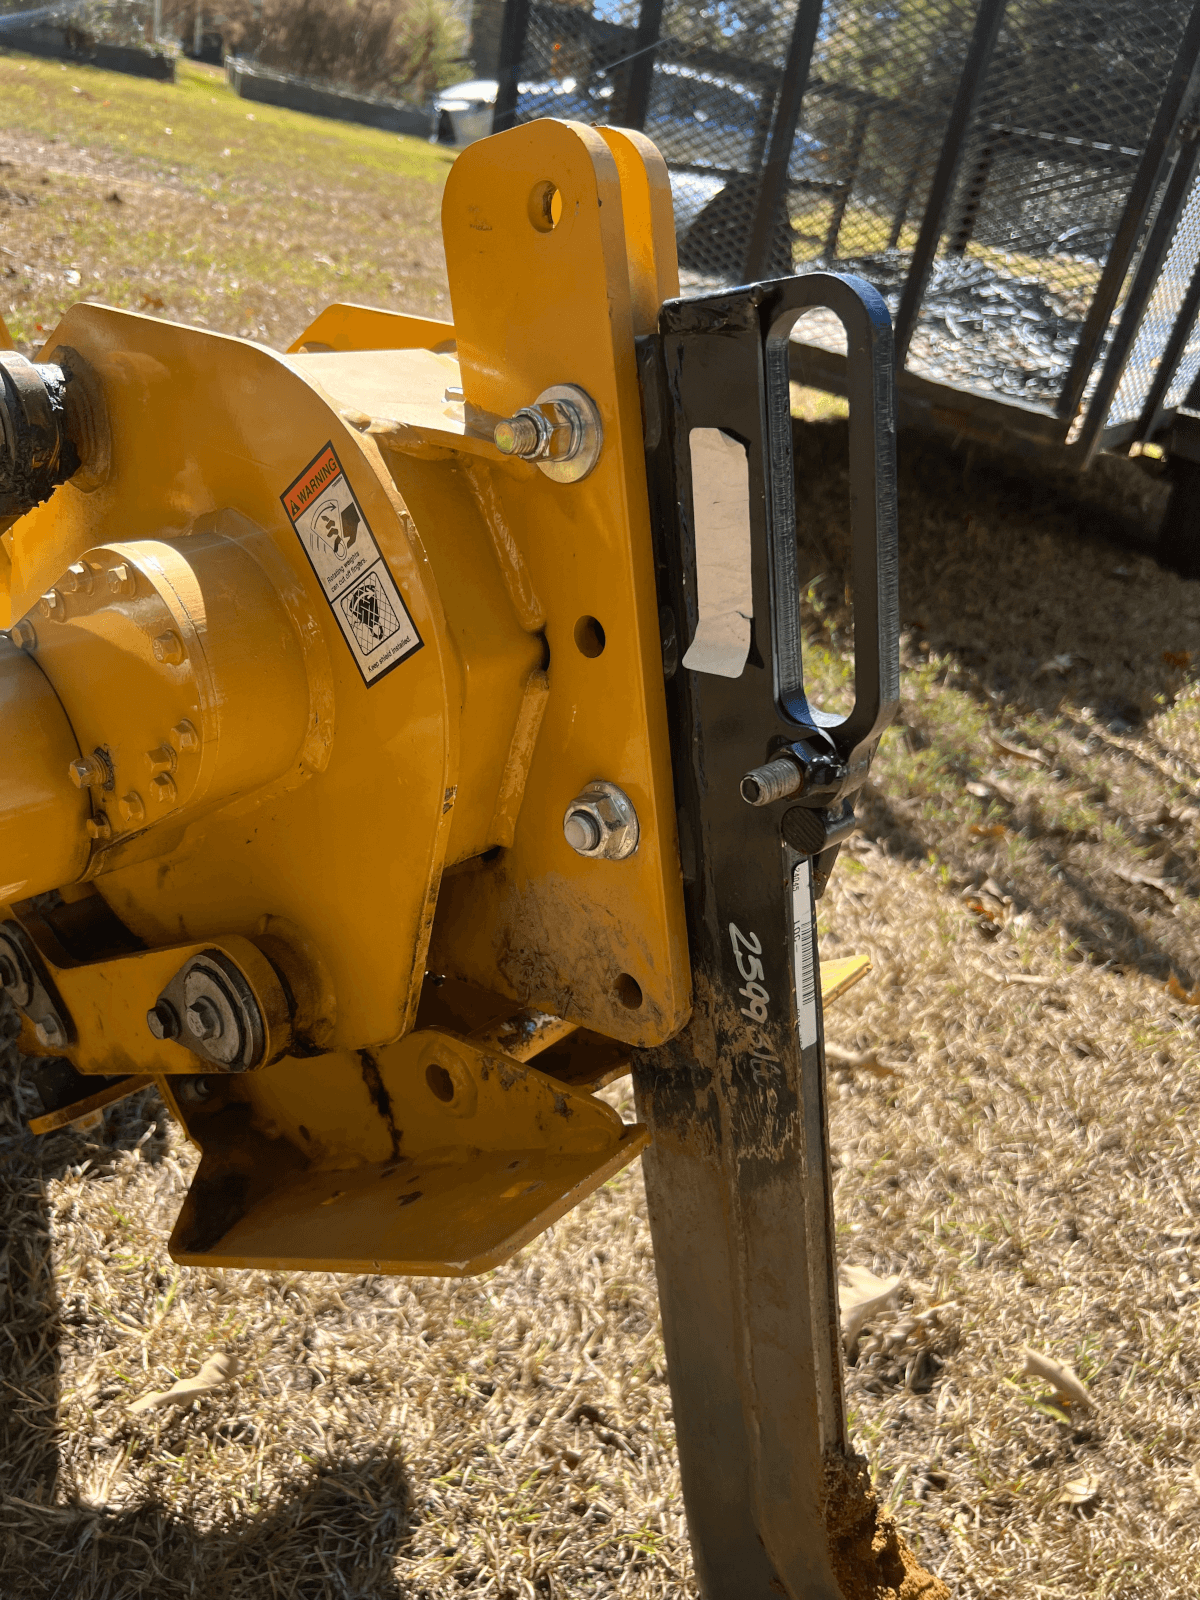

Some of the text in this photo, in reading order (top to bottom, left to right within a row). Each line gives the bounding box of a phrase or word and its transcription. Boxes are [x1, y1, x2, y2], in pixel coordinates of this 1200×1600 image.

[296, 457, 338, 505] WARNING
[326, 551, 360, 583] Rotating weights
[331, 583, 340, 592] can
[338, 576, 346, 586] cut
[350, 558, 367, 573] fingers.
[367, 635, 411, 672] Keep shield installed.
[728, 922, 770, 1024] 2599
